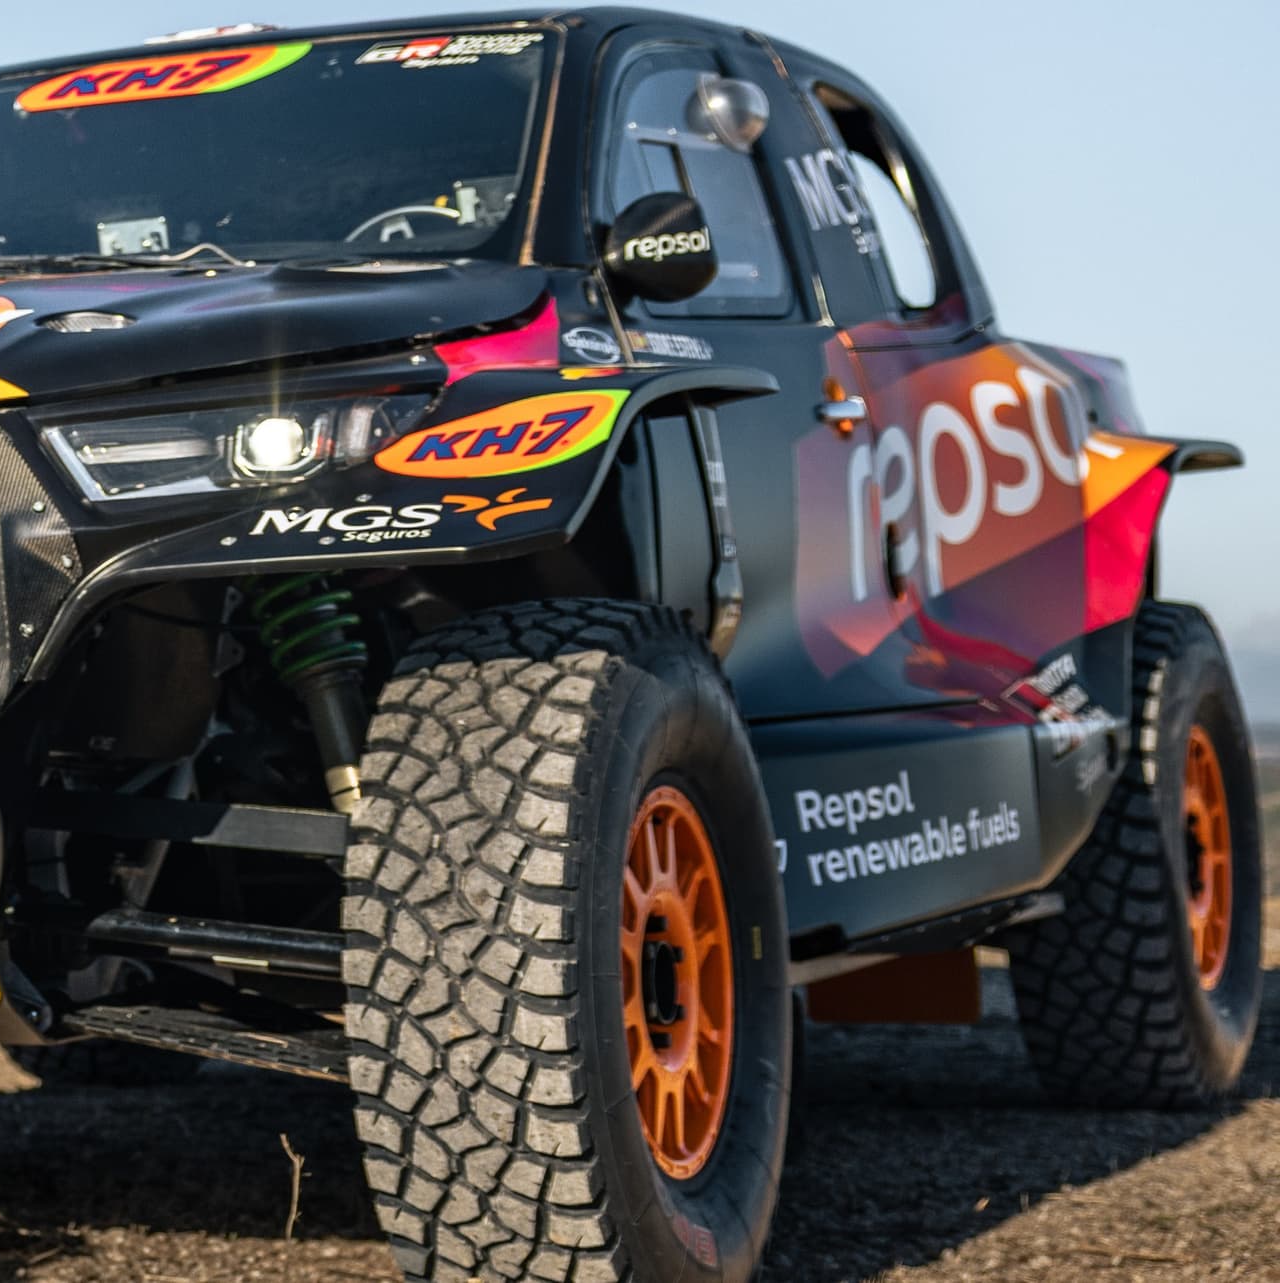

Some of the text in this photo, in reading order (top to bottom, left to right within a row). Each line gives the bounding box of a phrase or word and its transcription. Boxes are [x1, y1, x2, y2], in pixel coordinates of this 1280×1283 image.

[623, 225, 711, 262] repsol
[249, 504, 443, 535] MGS
[342, 529, 432, 544] Seguros
[795, 769, 915, 835] Repsol
[807, 800, 1021, 887] renewable fuels
